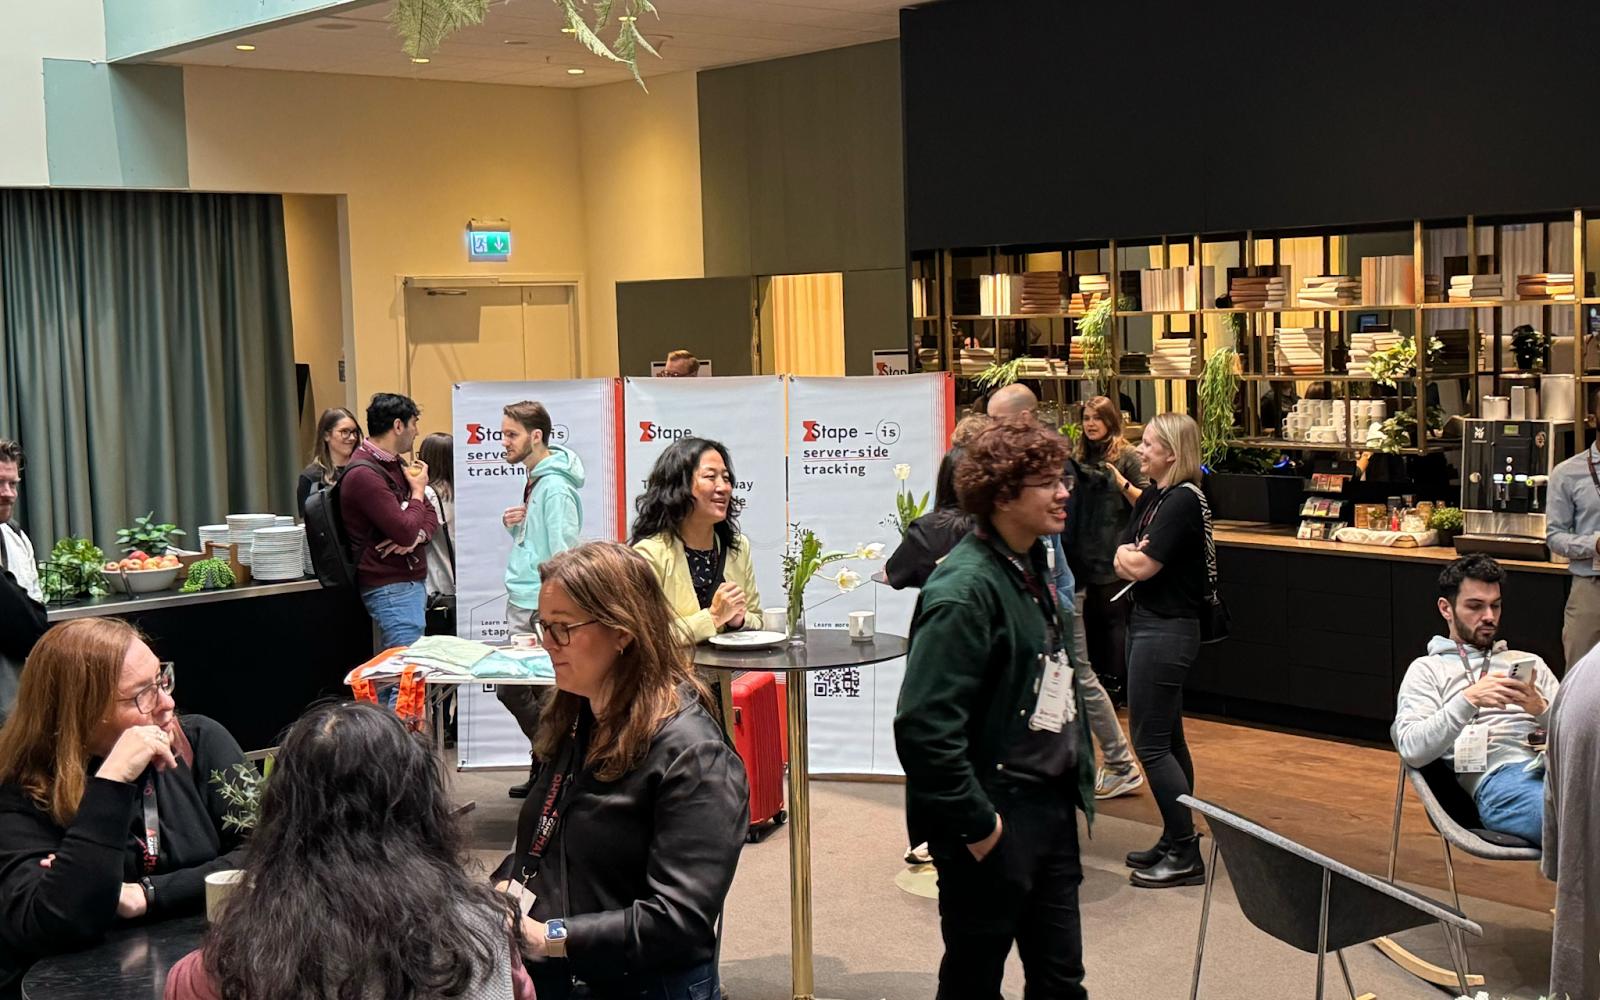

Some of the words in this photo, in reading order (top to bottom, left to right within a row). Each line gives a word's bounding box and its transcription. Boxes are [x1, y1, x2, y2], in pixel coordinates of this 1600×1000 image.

[476, 426, 503, 441] Sta
[648, 424, 692, 443] Stape
[811, 423, 858, 443] Stape
[881, 425, 896, 438] is
[803, 445, 889, 458] server-side
[467, 464, 525, 477] trackin
[803, 463, 866, 477] tracking
[481, 628, 509, 637] stap
